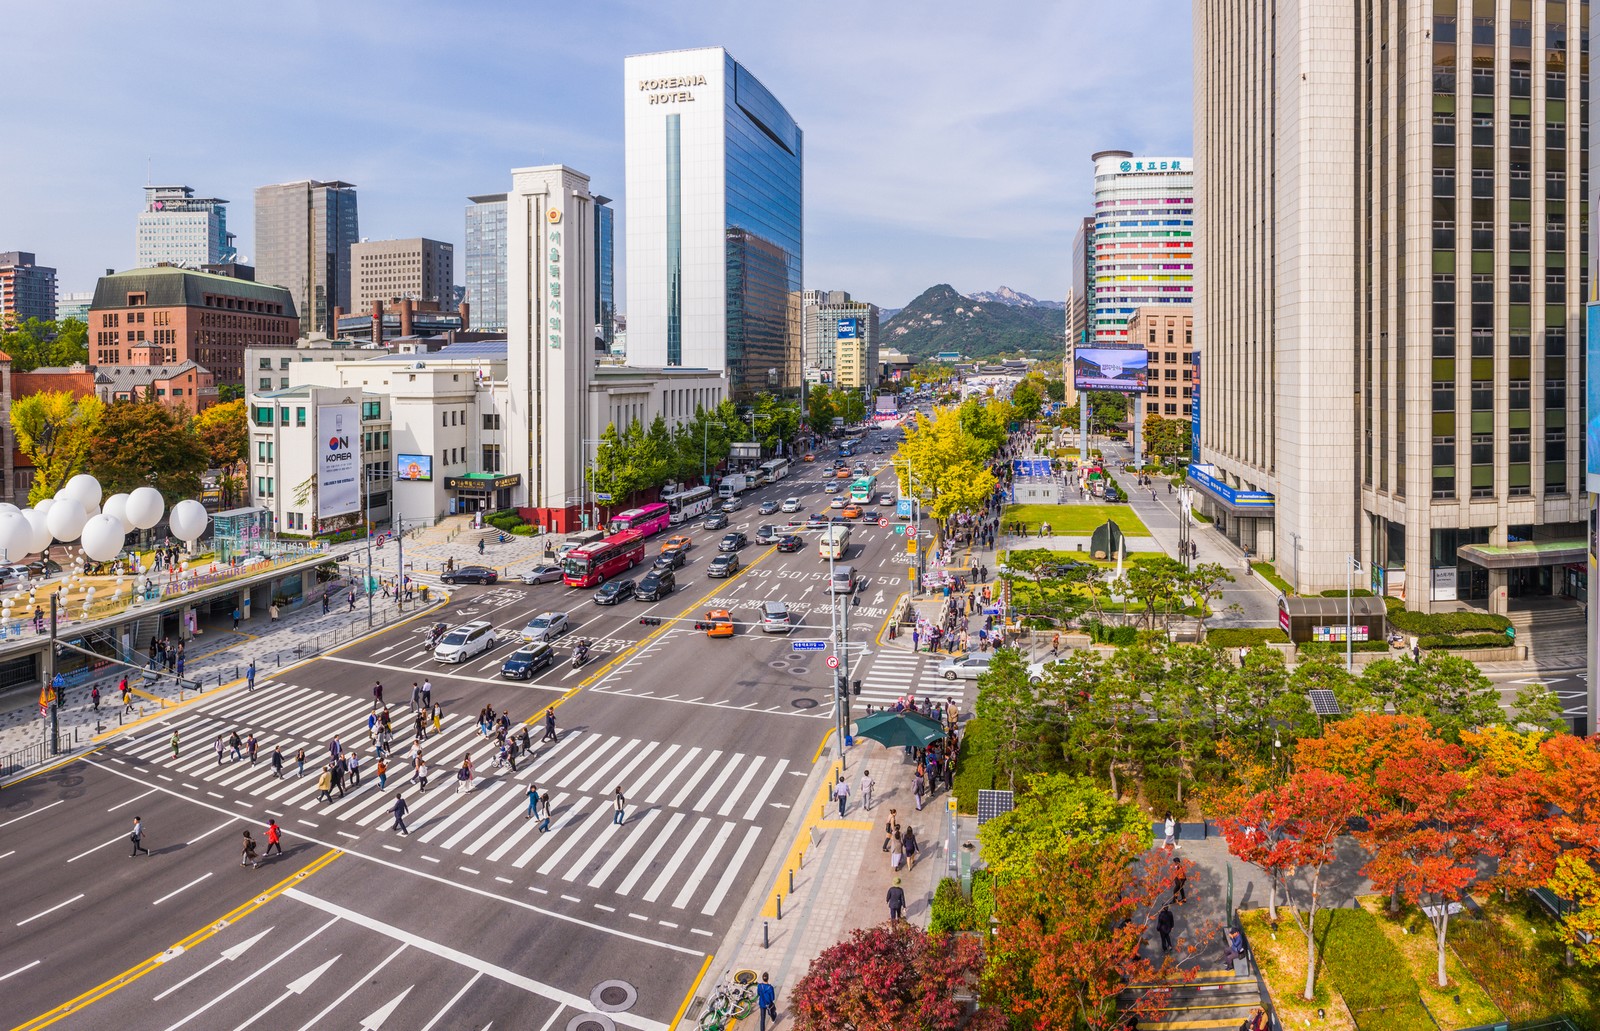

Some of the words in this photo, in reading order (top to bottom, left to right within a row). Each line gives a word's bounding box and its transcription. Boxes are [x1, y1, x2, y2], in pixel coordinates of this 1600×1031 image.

[638, 75, 707, 91] KOREANA
[649, 91, 695, 105] HOTEL
[549, 231, 561, 350] 서울특별시의회
[838, 325, 855, 333] Galaxy
[325, 452, 352, 463] KOREA
[165, 566, 247, 595] ARCHITECTURE
[250, 559, 270, 572] AND
[273, 549, 321, 565] URBANISM
[747, 569, 772, 578] 50
[777, 570, 802, 579] 50
[877, 576, 901, 586] 50
[853, 606, 888, 619] 청계천
